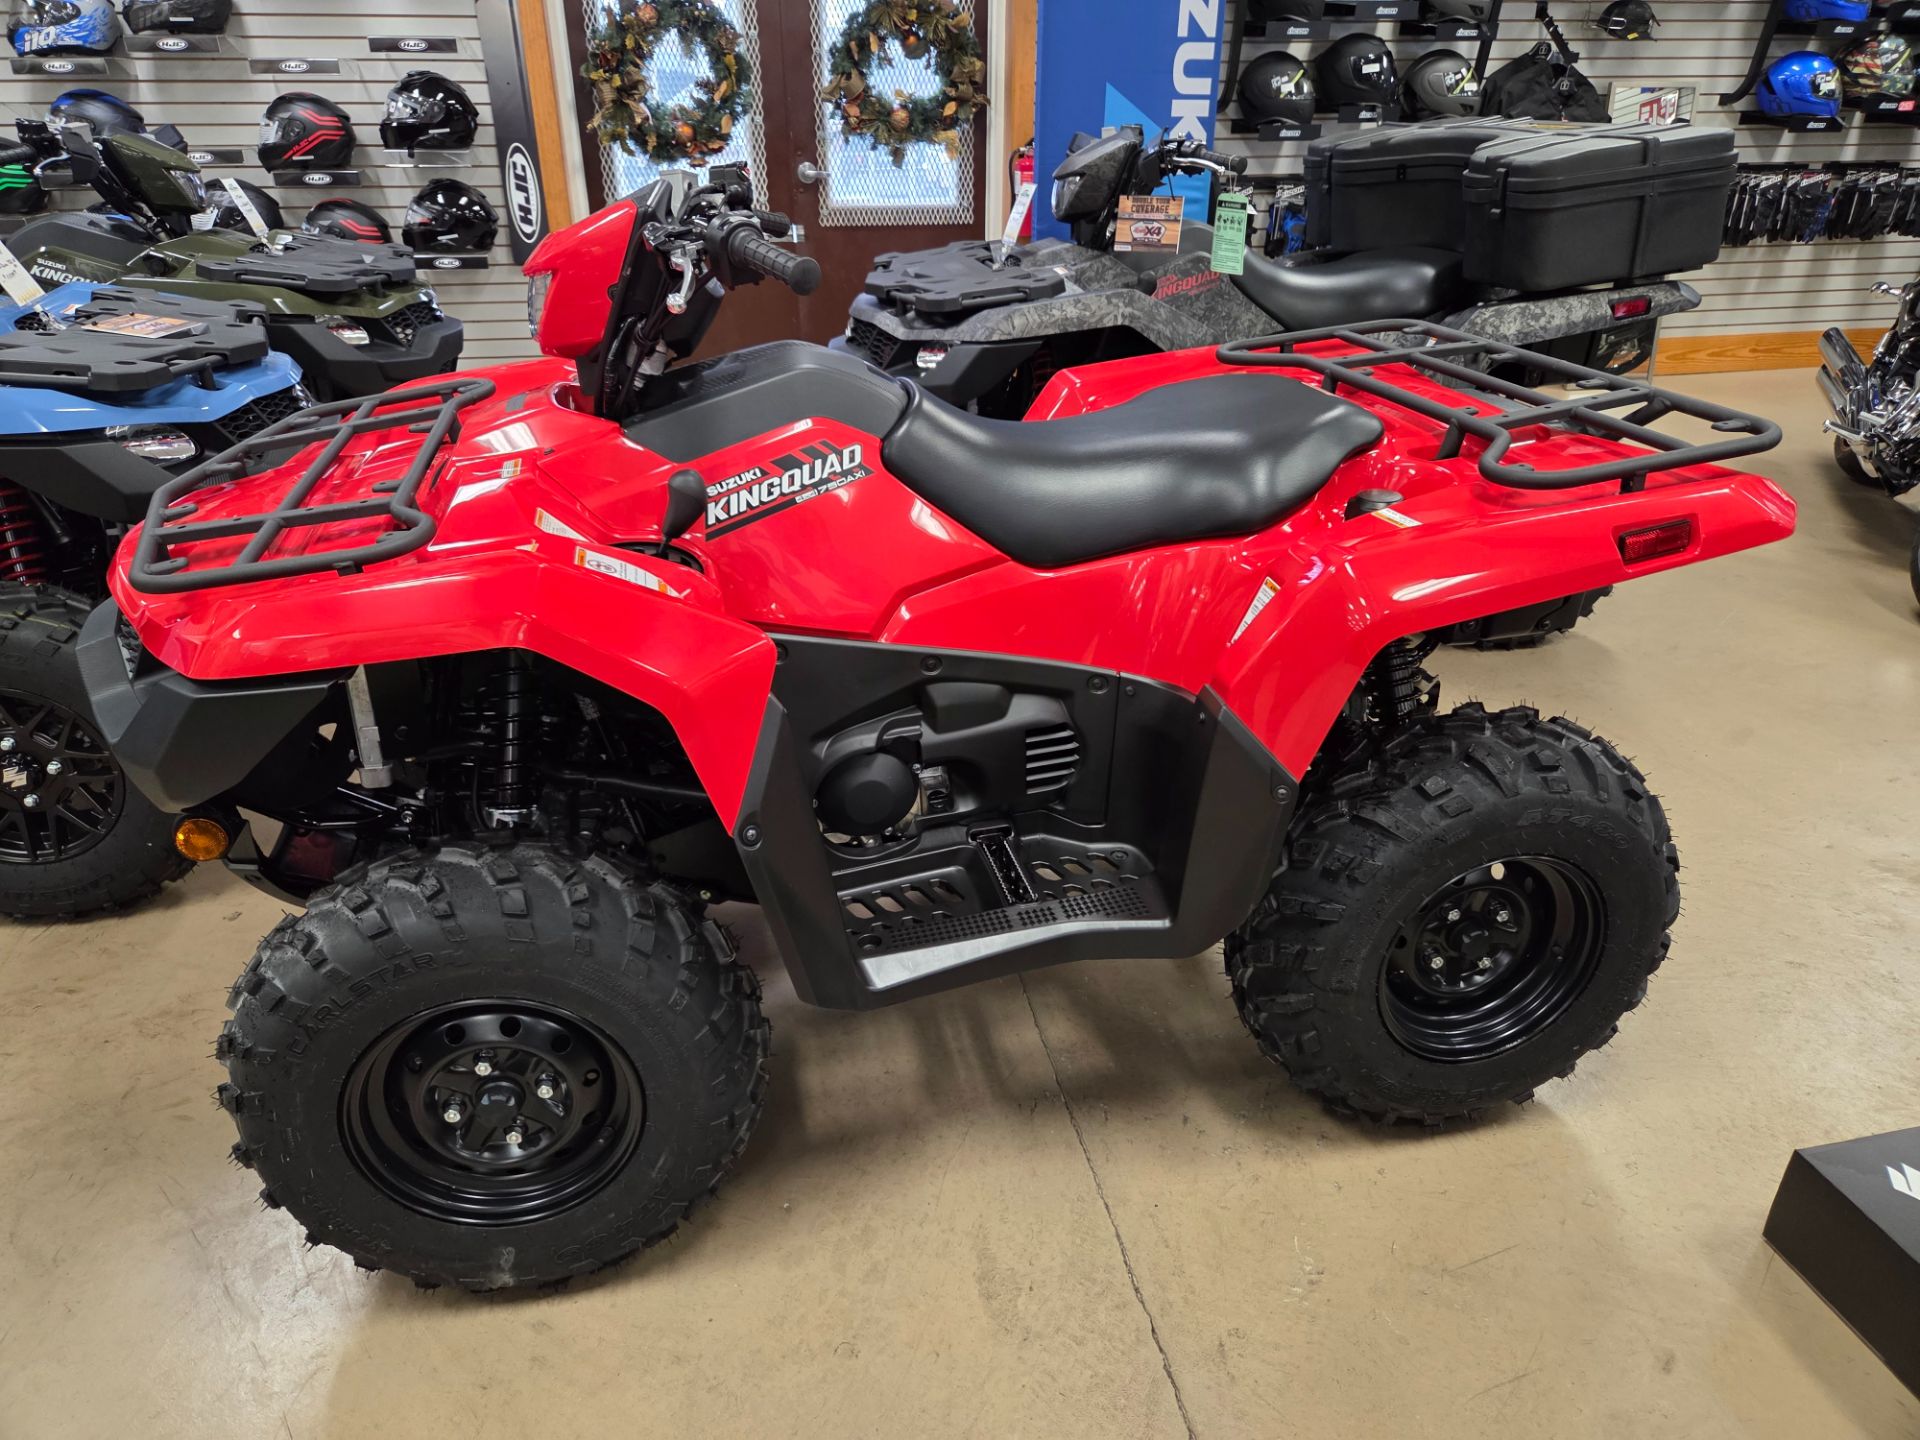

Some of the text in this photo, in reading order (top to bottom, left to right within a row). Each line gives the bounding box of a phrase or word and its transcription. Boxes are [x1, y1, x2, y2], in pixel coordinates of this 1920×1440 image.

[512, 161, 534, 228] HJC
[1131, 204, 1170, 214] COVERAGE
[37, 258, 66, 270] SUZUKI
[706, 467, 763, 497] SUZUKI
[707, 444, 862, 526] KINGQUAD
